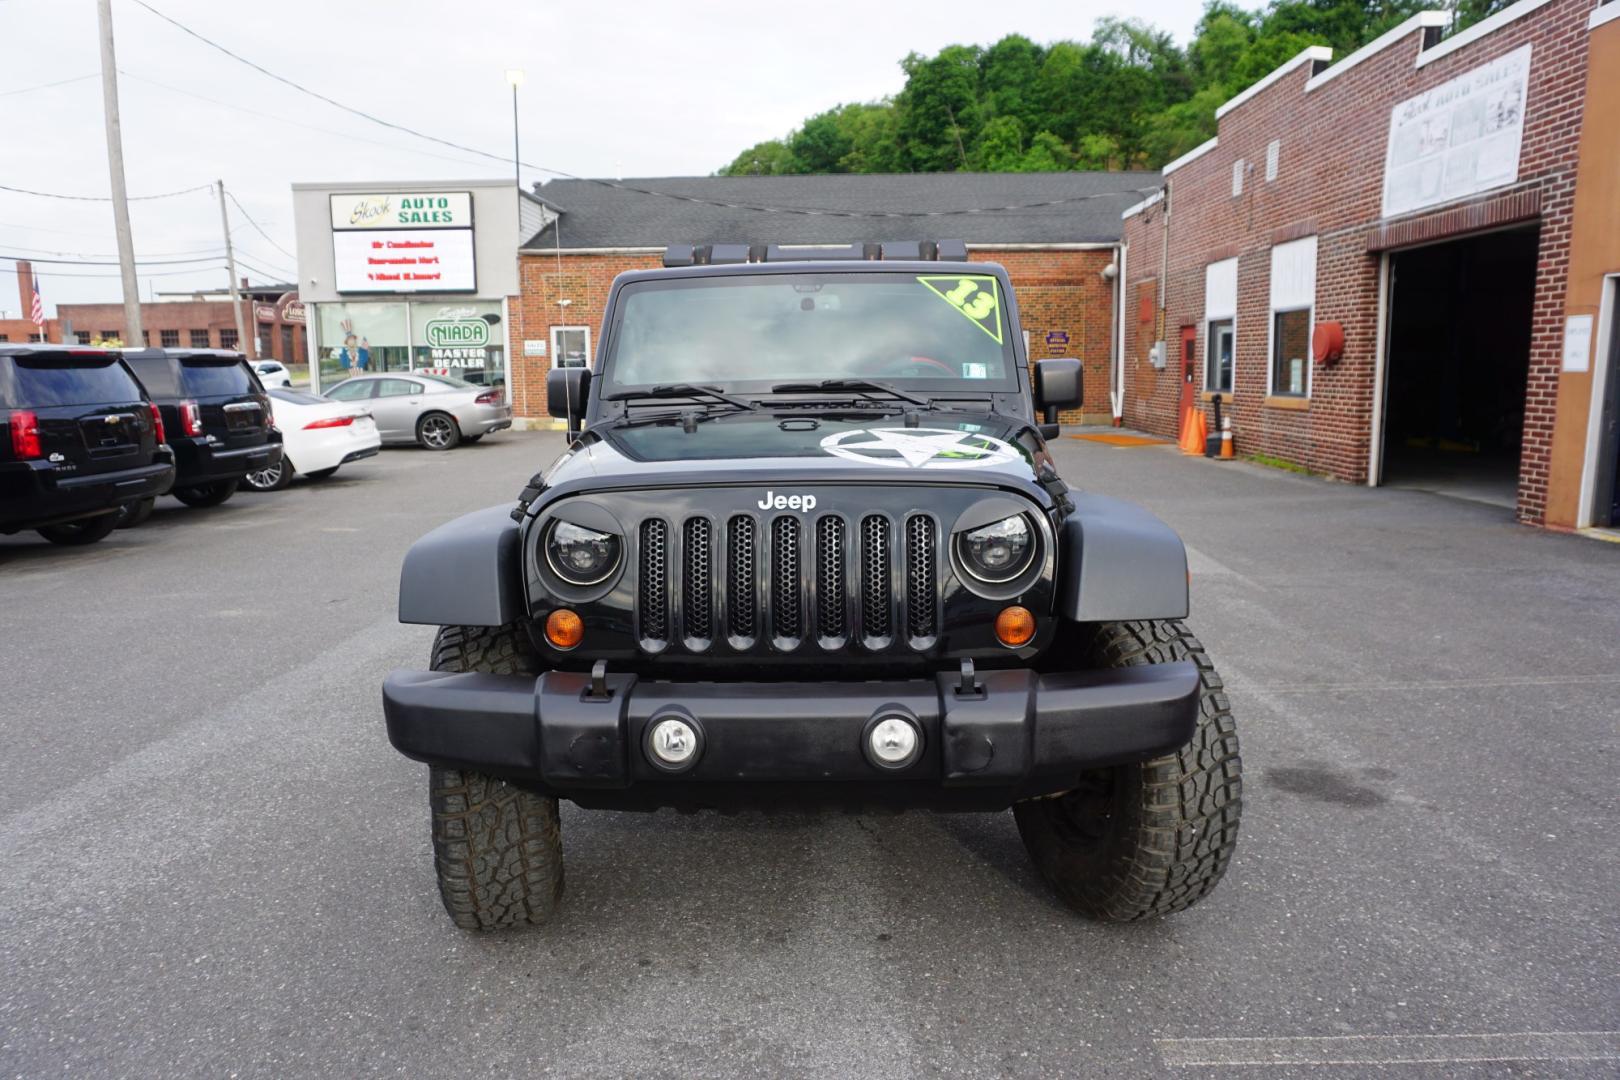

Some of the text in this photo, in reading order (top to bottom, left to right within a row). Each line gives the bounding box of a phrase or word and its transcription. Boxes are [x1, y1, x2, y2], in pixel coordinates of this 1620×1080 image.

[401, 197, 449, 209] AUTO
[350, 196, 391, 225] Skook
[398, 211, 453, 223] SALES
[946, 279, 996, 320] 13
[431, 325, 483, 342] NIADA
[431, 348, 486, 359] MASTER
[434, 359, 485, 368] DEALER
[758, 491, 816, 513] Jeep
